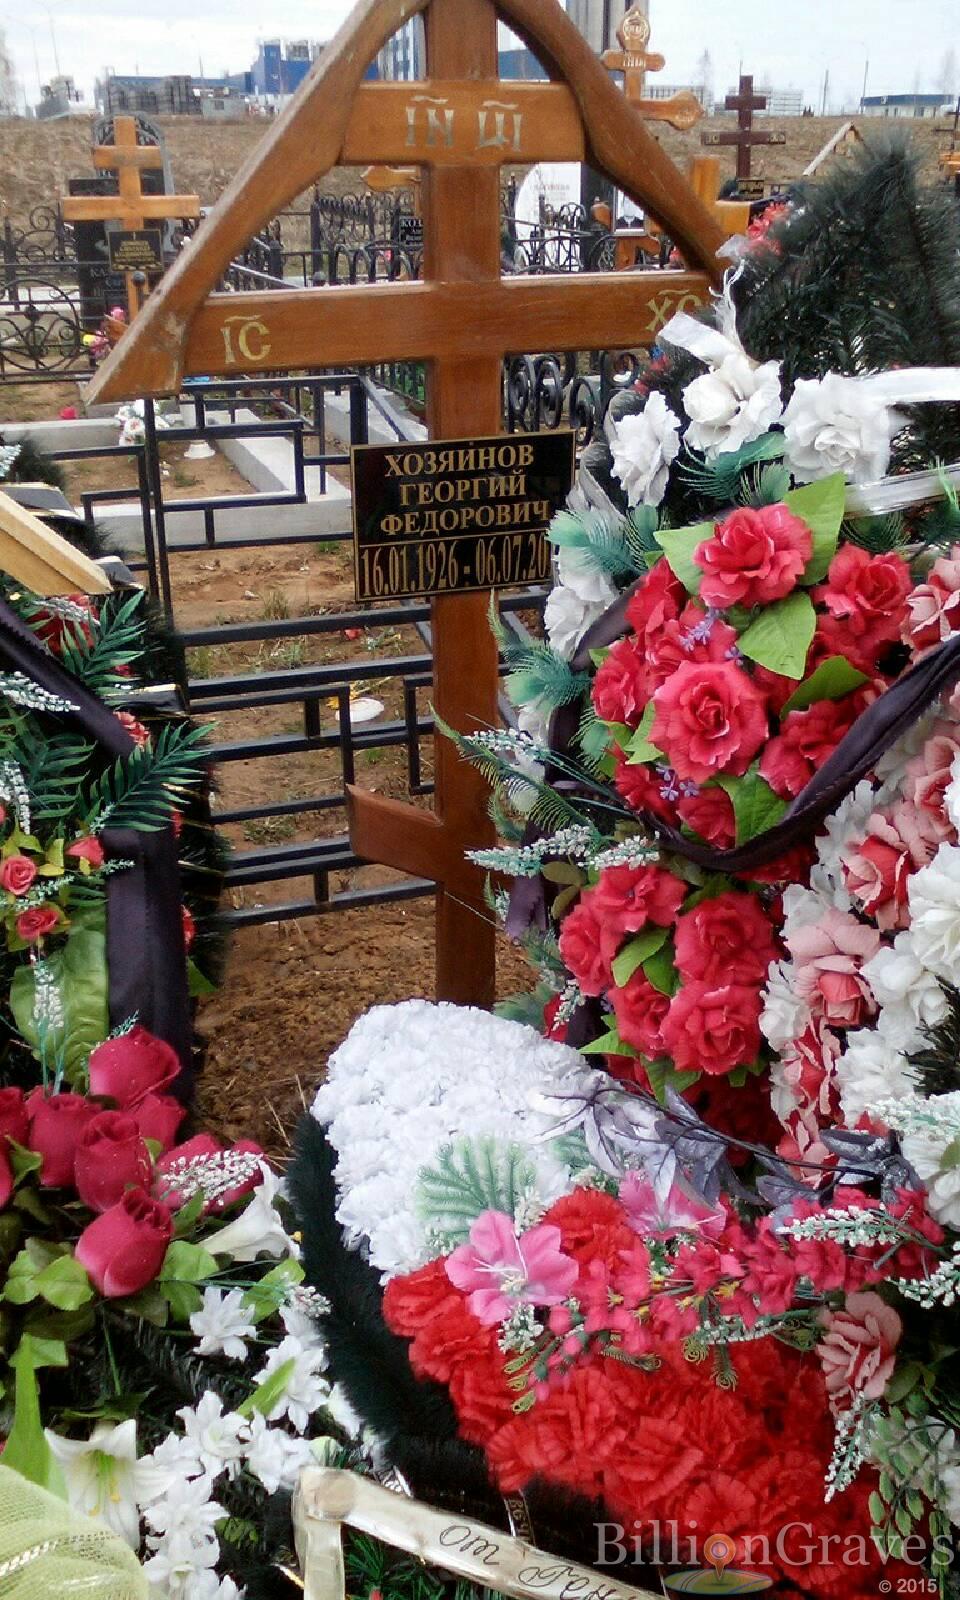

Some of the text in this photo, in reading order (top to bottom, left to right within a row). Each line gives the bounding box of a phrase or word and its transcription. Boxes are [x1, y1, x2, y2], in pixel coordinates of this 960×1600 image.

[384, 444, 534, 477] ХОЗЯИНОВ
[400, 468, 526, 506] ГЕОРГИЙ
[380, 500, 549, 537] ФЕДОРОВИЧ
[361, 541, 459, 597] 16.01.1926
[475, 531, 547, 585] 06.07.20
